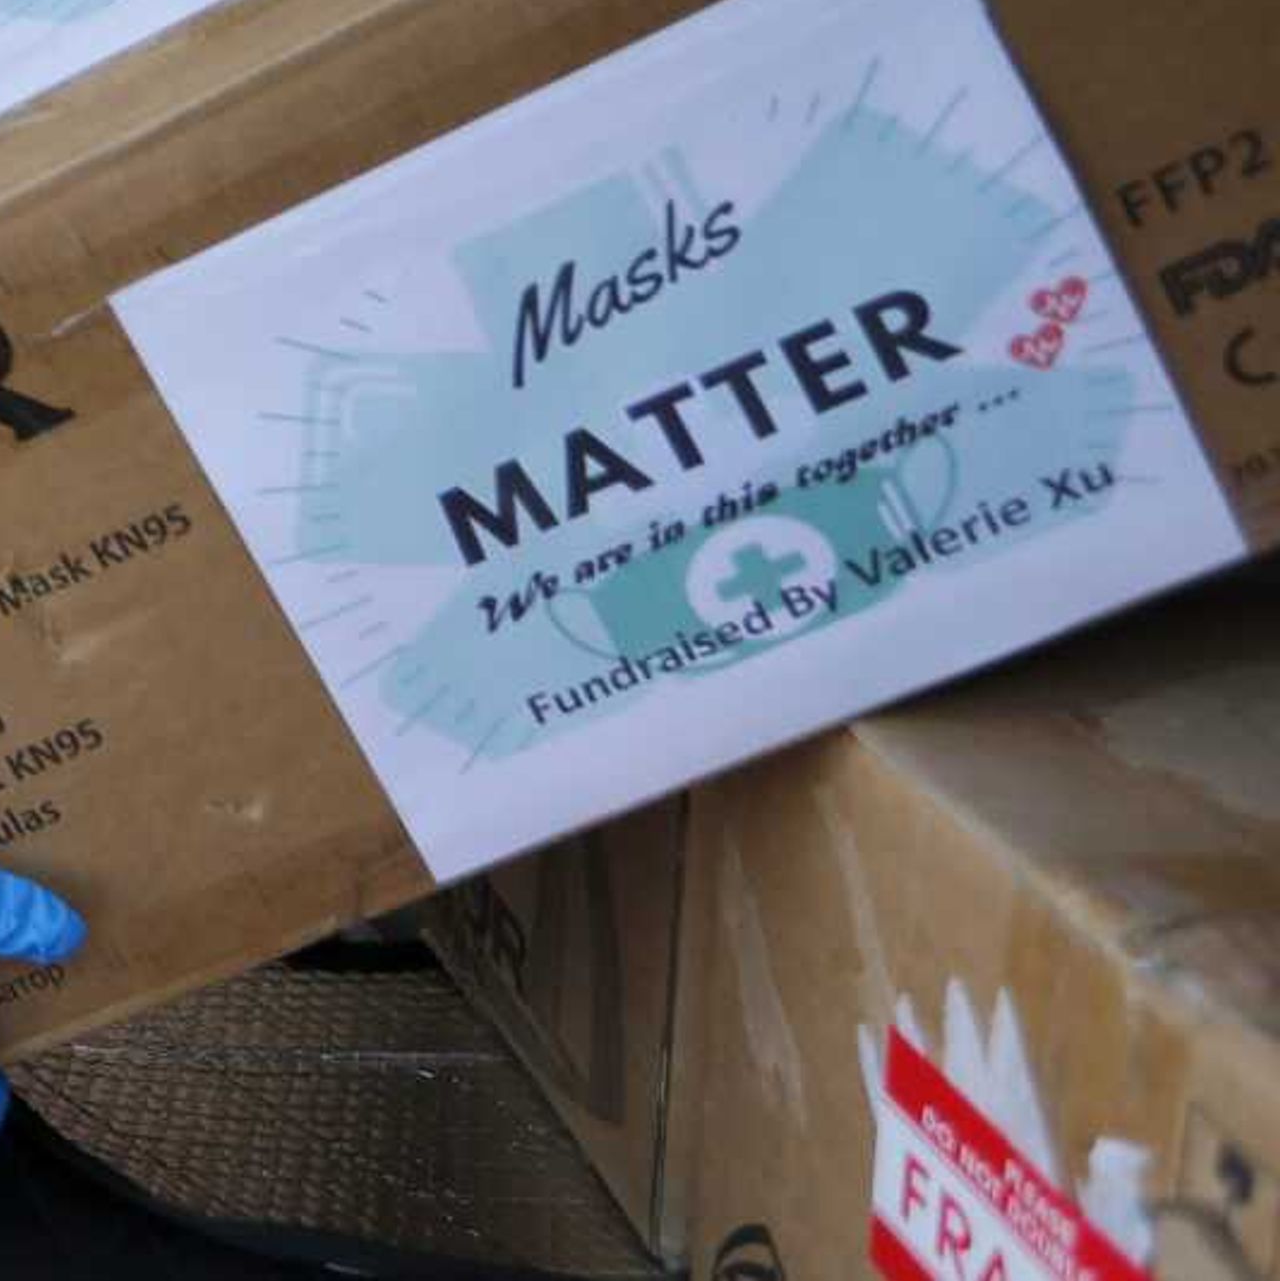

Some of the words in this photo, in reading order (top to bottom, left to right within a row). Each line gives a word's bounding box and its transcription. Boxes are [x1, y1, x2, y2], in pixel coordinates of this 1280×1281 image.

[1117, 129, 1270, 226] FFP2
[512, 198, 742, 389] Masks
[439, 290, 964, 566] MATTER
[477, 571, 560, 634] We
[574, 543, 633, 584] are
[648, 519, 686, 552] in
[702, 481, 780, 528] this
[797, 403, 960, 489] together
[90, 504, 192, 570] KN95
[526, 601, 774, 726] Fundraised
[780, 579, 839, 620] By
[843, 496, 1031, 588] Valerie
[1040, 462, 1115, 510] Xu
[6, 719, 105, 782] KN95
